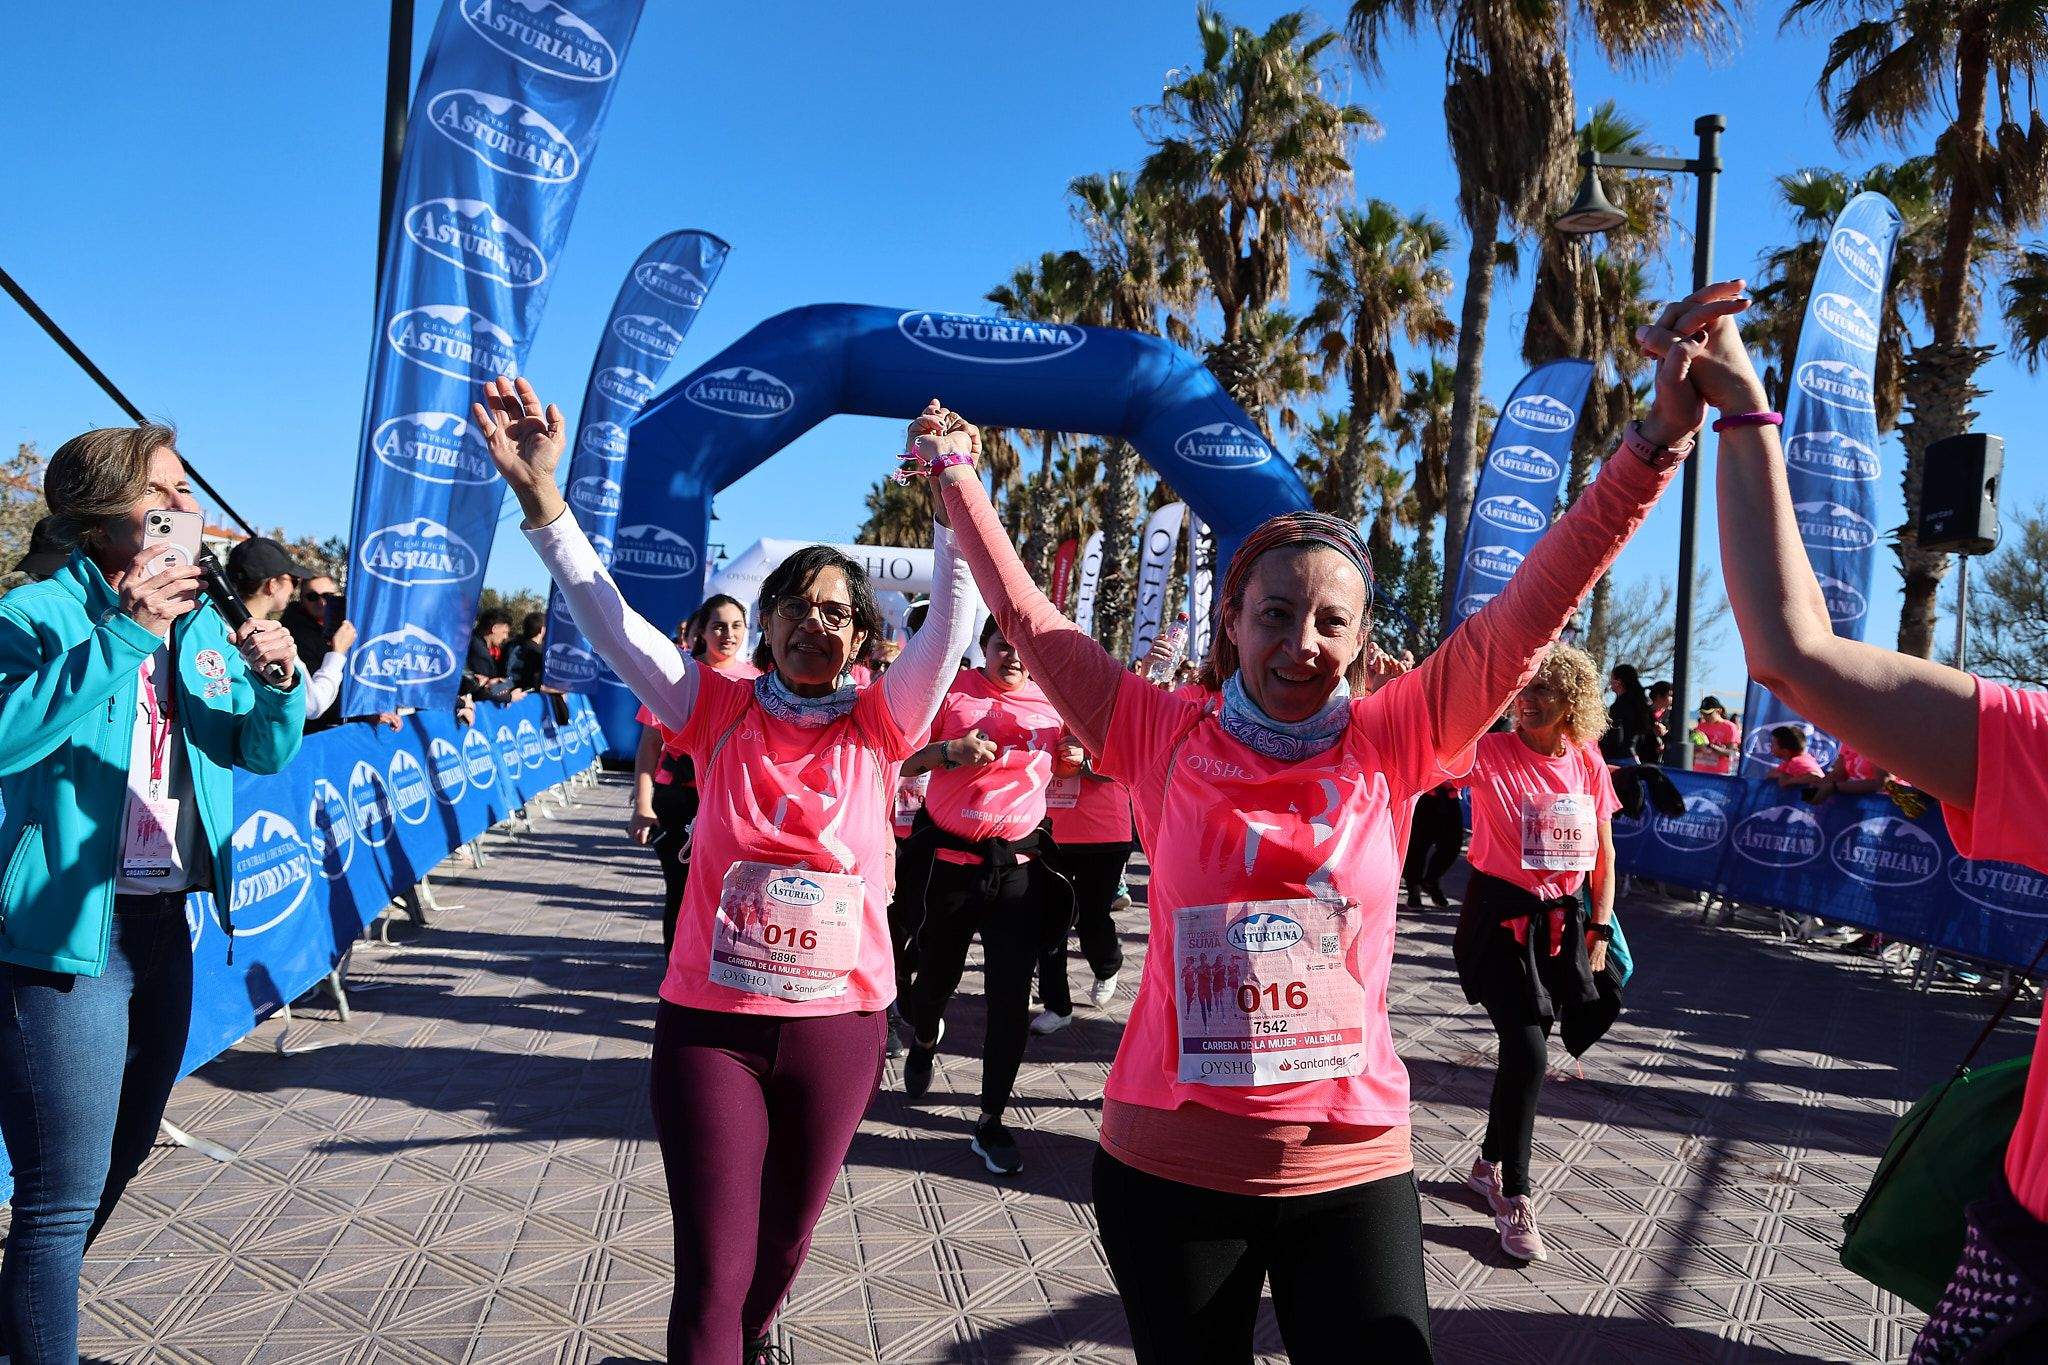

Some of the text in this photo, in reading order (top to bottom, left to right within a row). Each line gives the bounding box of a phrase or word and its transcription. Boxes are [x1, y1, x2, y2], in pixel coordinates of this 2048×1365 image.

[469, 0, 601, 76] ASTURIANA
[437, 100, 566, 177] ASTURIANA
[913, 315, 1074, 345] ASTURIANA
[397, 321, 519, 382] ASTURIANA
[693, 382, 785, 410] ASTURIANA
[1511, 403, 1569, 427] ASTURIANA
[381, 428, 488, 479] ASTURIANA
[1183, 438, 1266, 459] ASTURIANA
[1790, 442, 1878, 475] ASTURIANA
[1496, 452, 1553, 478] ASTURIANA
[1482, 502, 1540, 528] ASTURIANA
[1800, 522, 1867, 544] TURIANA
[617, 547, 691, 571] STURIANA
[1474, 553, 1517, 574] ASTURIA
[961, 808, 993, 821] CARRERA
[1553, 828, 1582, 840] 016
[1658, 816, 1721, 841] ASTURIANA
[1739, 824, 1816, 856] ASTURIANA
[1837, 836, 1929, 875] ASTURIANA
[771, 883, 821, 901] ASTURIANA
[763, 924, 818, 950] 016
[1189, 938, 1222, 949] SUMA
[1233, 928, 1298, 944] ASTURIANA
[727, 956, 757, 968] CARRERA
[758, 961, 767, 970] DE
[768, 963, 777, 972] LA
[778, 965, 800, 975] MUJER
[806, 969, 836, 979] VALENCIA
[771, 952, 796, 964] 8896
[722, 969, 767, 987] OYSHO
[1237, 981, 1308, 1014] 016
[1253, 1019, 1288, 1035] 7542
[1202, 1040, 1238, 1050] CARRERA
[1241, 1040, 1251, 1050] DE
[1254, 1040, 1266, 1049] LA
[1268, 1037, 1297, 1049] MUJER
[1303, 1033, 1343, 1045] VALENCIA
[1201, 1060, 1257, 1075] OYSHO
[1293, 1056, 1347, 1071] Santander
